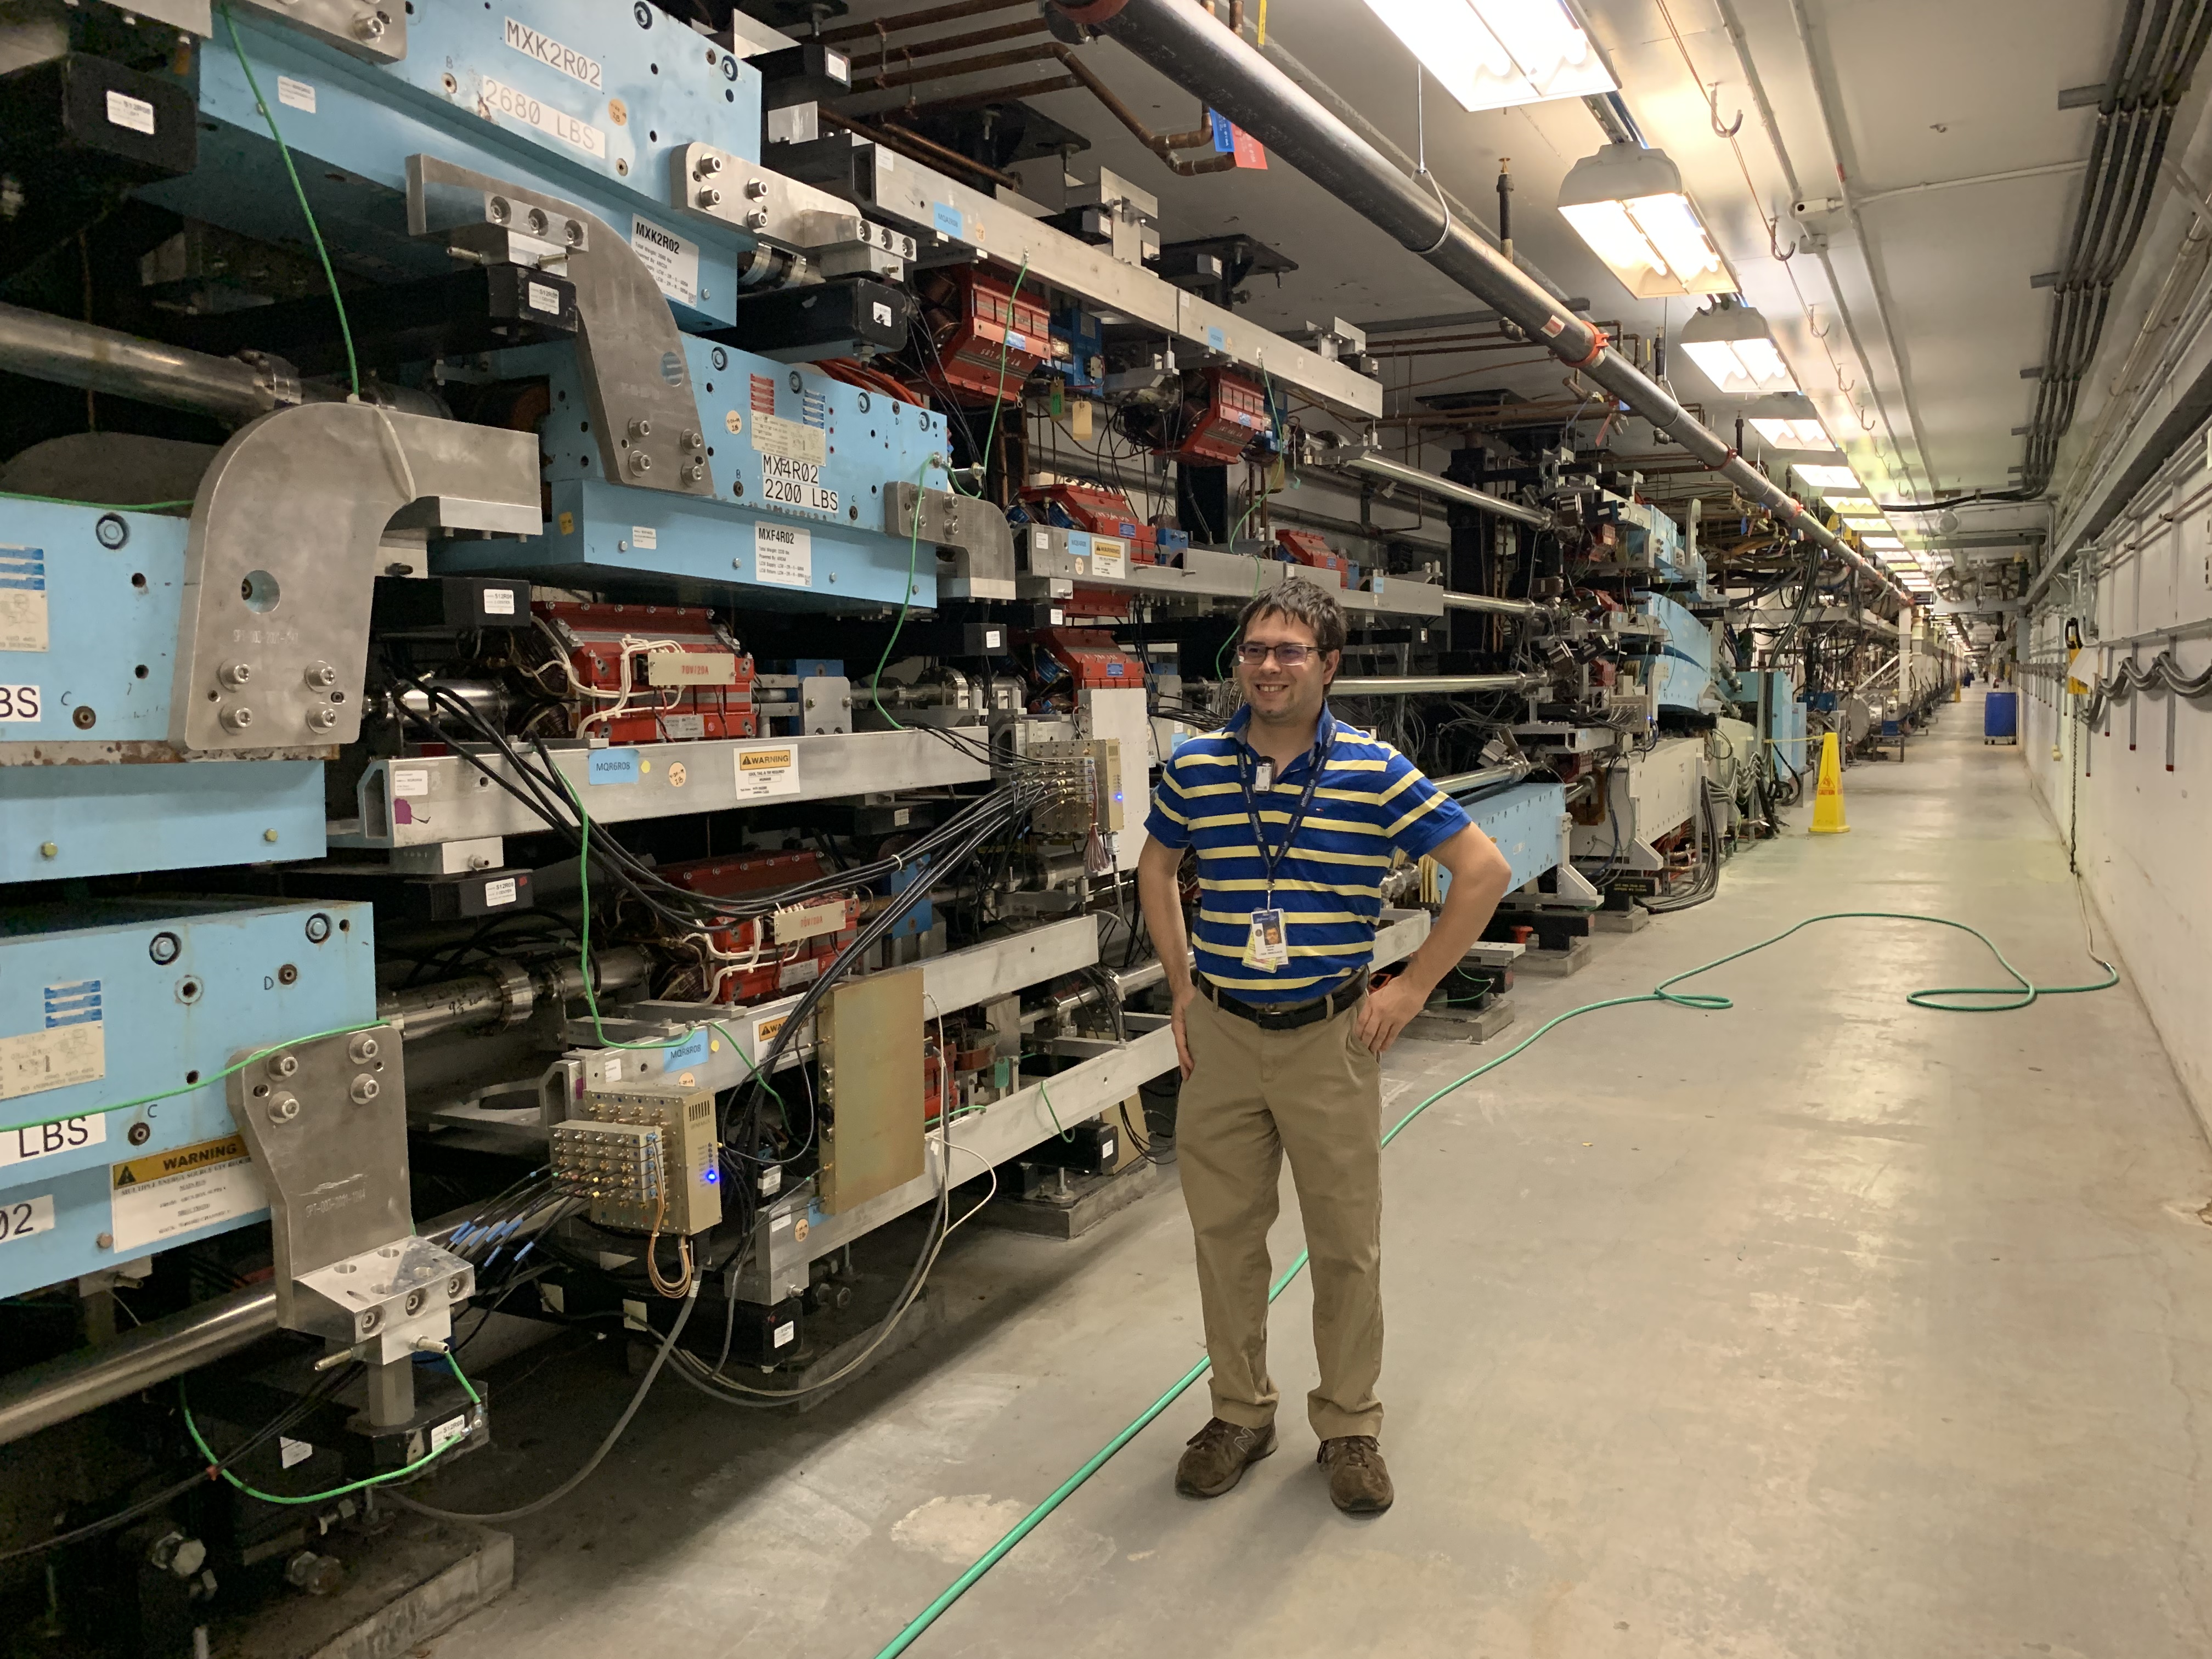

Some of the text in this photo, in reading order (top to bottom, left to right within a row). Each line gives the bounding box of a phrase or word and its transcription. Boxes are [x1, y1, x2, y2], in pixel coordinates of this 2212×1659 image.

[506, 20, 600, 87] MXK2R02
[486, 80, 595, 150] 2680 LBS
[636, 222, 680, 255] MXK2R02
[765, 478, 838, 511] 2200 LBS
[759, 527, 794, 544] MXF4R02
[596, 761, 630, 771] MQR6R08
[752, 755, 788, 764] WARNING
[263, 975, 274, 991] D
[670, 1044, 702, 1058] MQR8R08
[147, 1104, 157, 1118] C
[19, 1116, 88, 1158] LBS
[163, 1143, 237, 1171] WARNING
